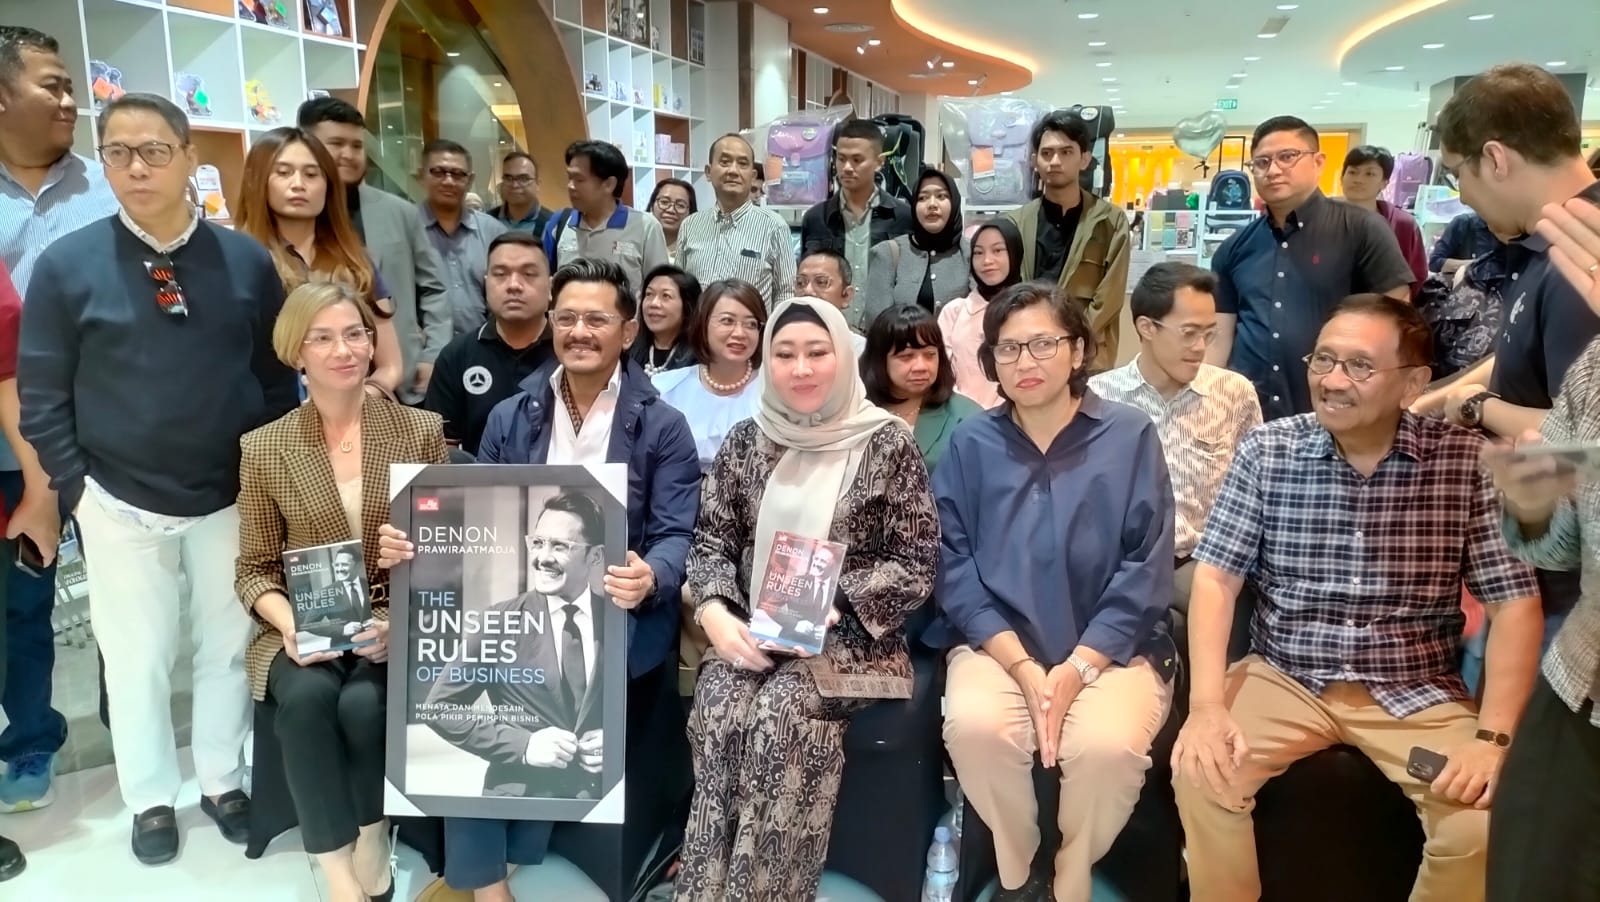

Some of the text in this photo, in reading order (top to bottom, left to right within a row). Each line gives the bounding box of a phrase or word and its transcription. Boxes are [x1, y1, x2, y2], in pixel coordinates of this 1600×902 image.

[419, 526, 497, 543] DENON
[418, 545, 516, 554] PRAWIRAATMADJA
[776, 544, 804, 556] DENON
[290, 562, 322, 573] DENON
[769, 571, 813, 590] UNSEEN
[295, 587, 343, 602] UNSEEN
[766, 581, 801, 597] RULES
[297, 598, 335, 612] RULES
[418, 591, 455, 607] THE
[418, 609, 545, 635] UNSEEN
[417, 638, 517, 664] RULES
[416, 666, 545, 684] OF BUSINESS
[415, 703, 449, 711] MENATA
[441, 713, 463, 721] PIKIR
[466, 714, 508, 722] PEMIMPIN
[511, 714, 540, 723] BISNIS
